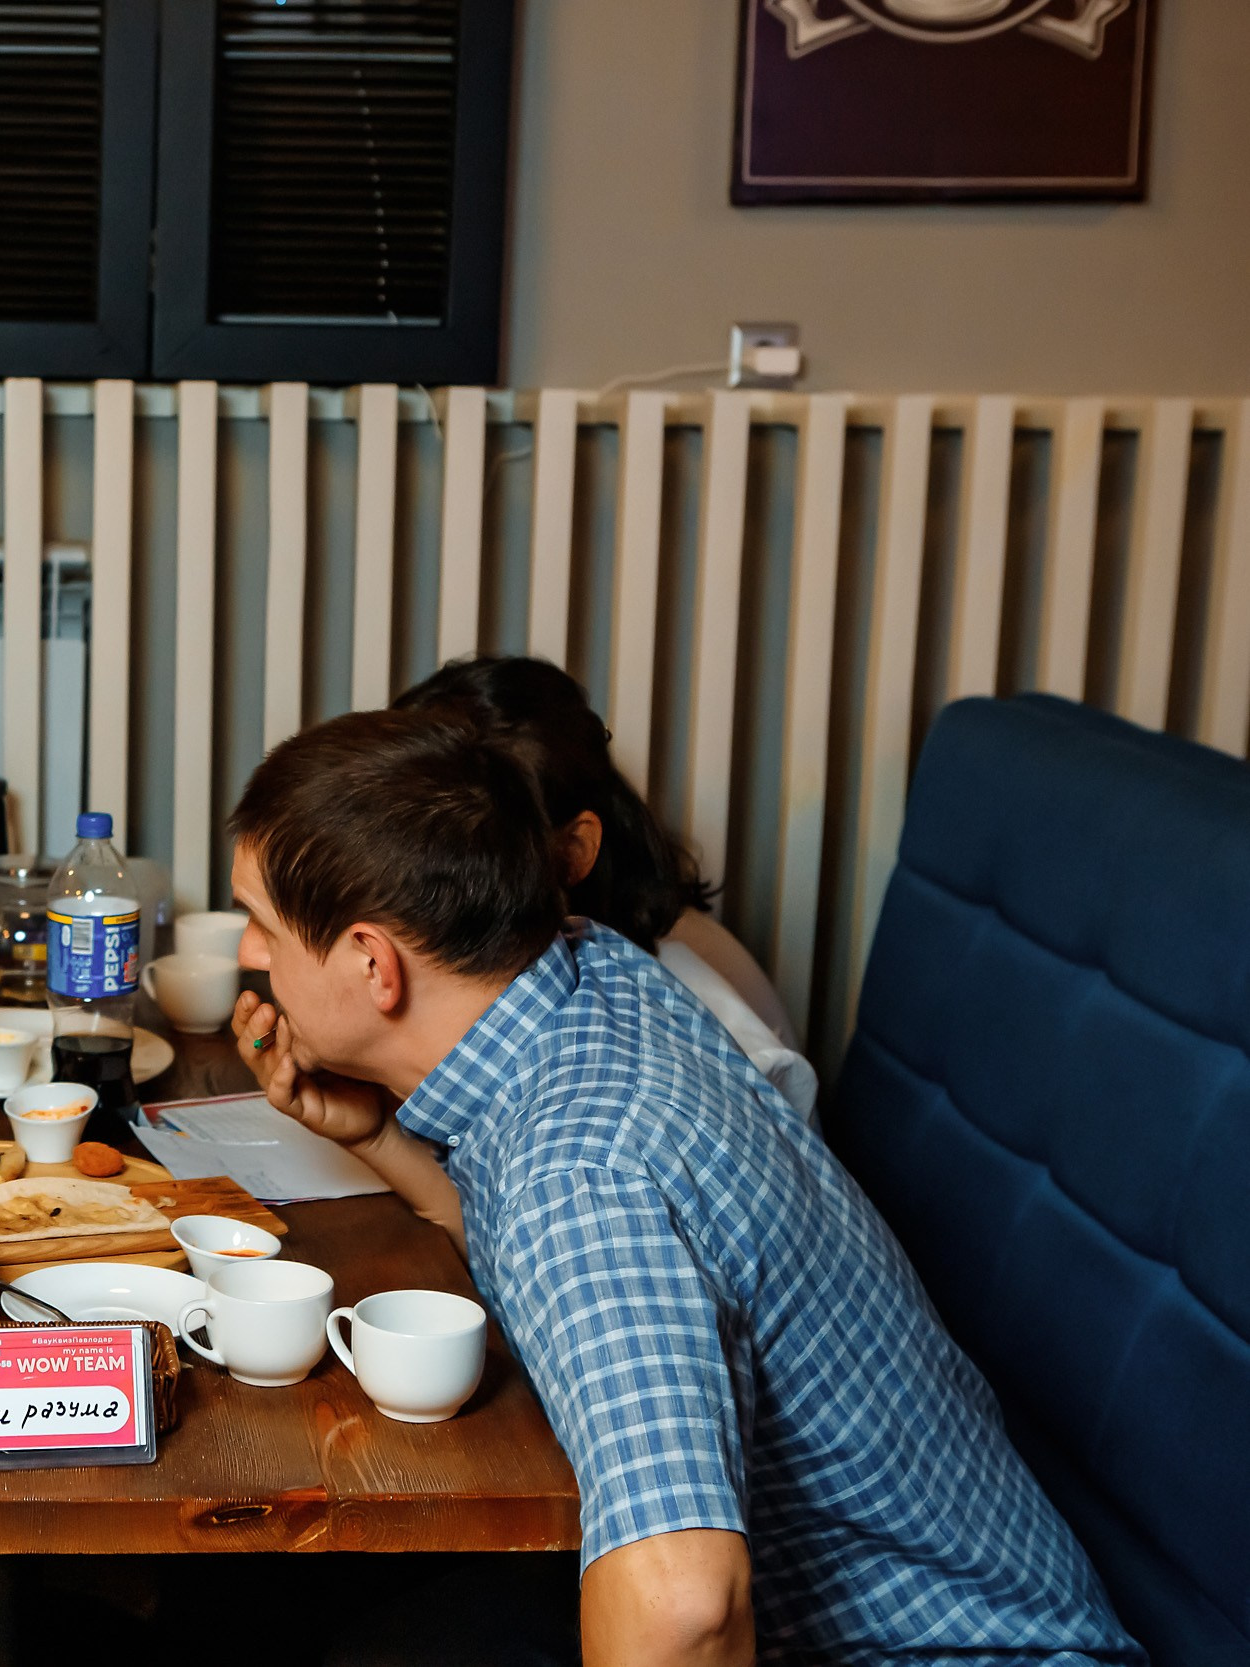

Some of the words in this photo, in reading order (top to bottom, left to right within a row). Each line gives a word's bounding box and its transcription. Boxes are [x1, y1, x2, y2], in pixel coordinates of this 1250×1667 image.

[104, 927, 120, 992] PEPSI
[62, 1348, 76, 1356] my
[106, 1346, 114, 1354] is
[16, 1356, 70, 1373] WOW
[73, 1355, 125, 1372] TEAM
[21, 1399, 119, 1430] разума
